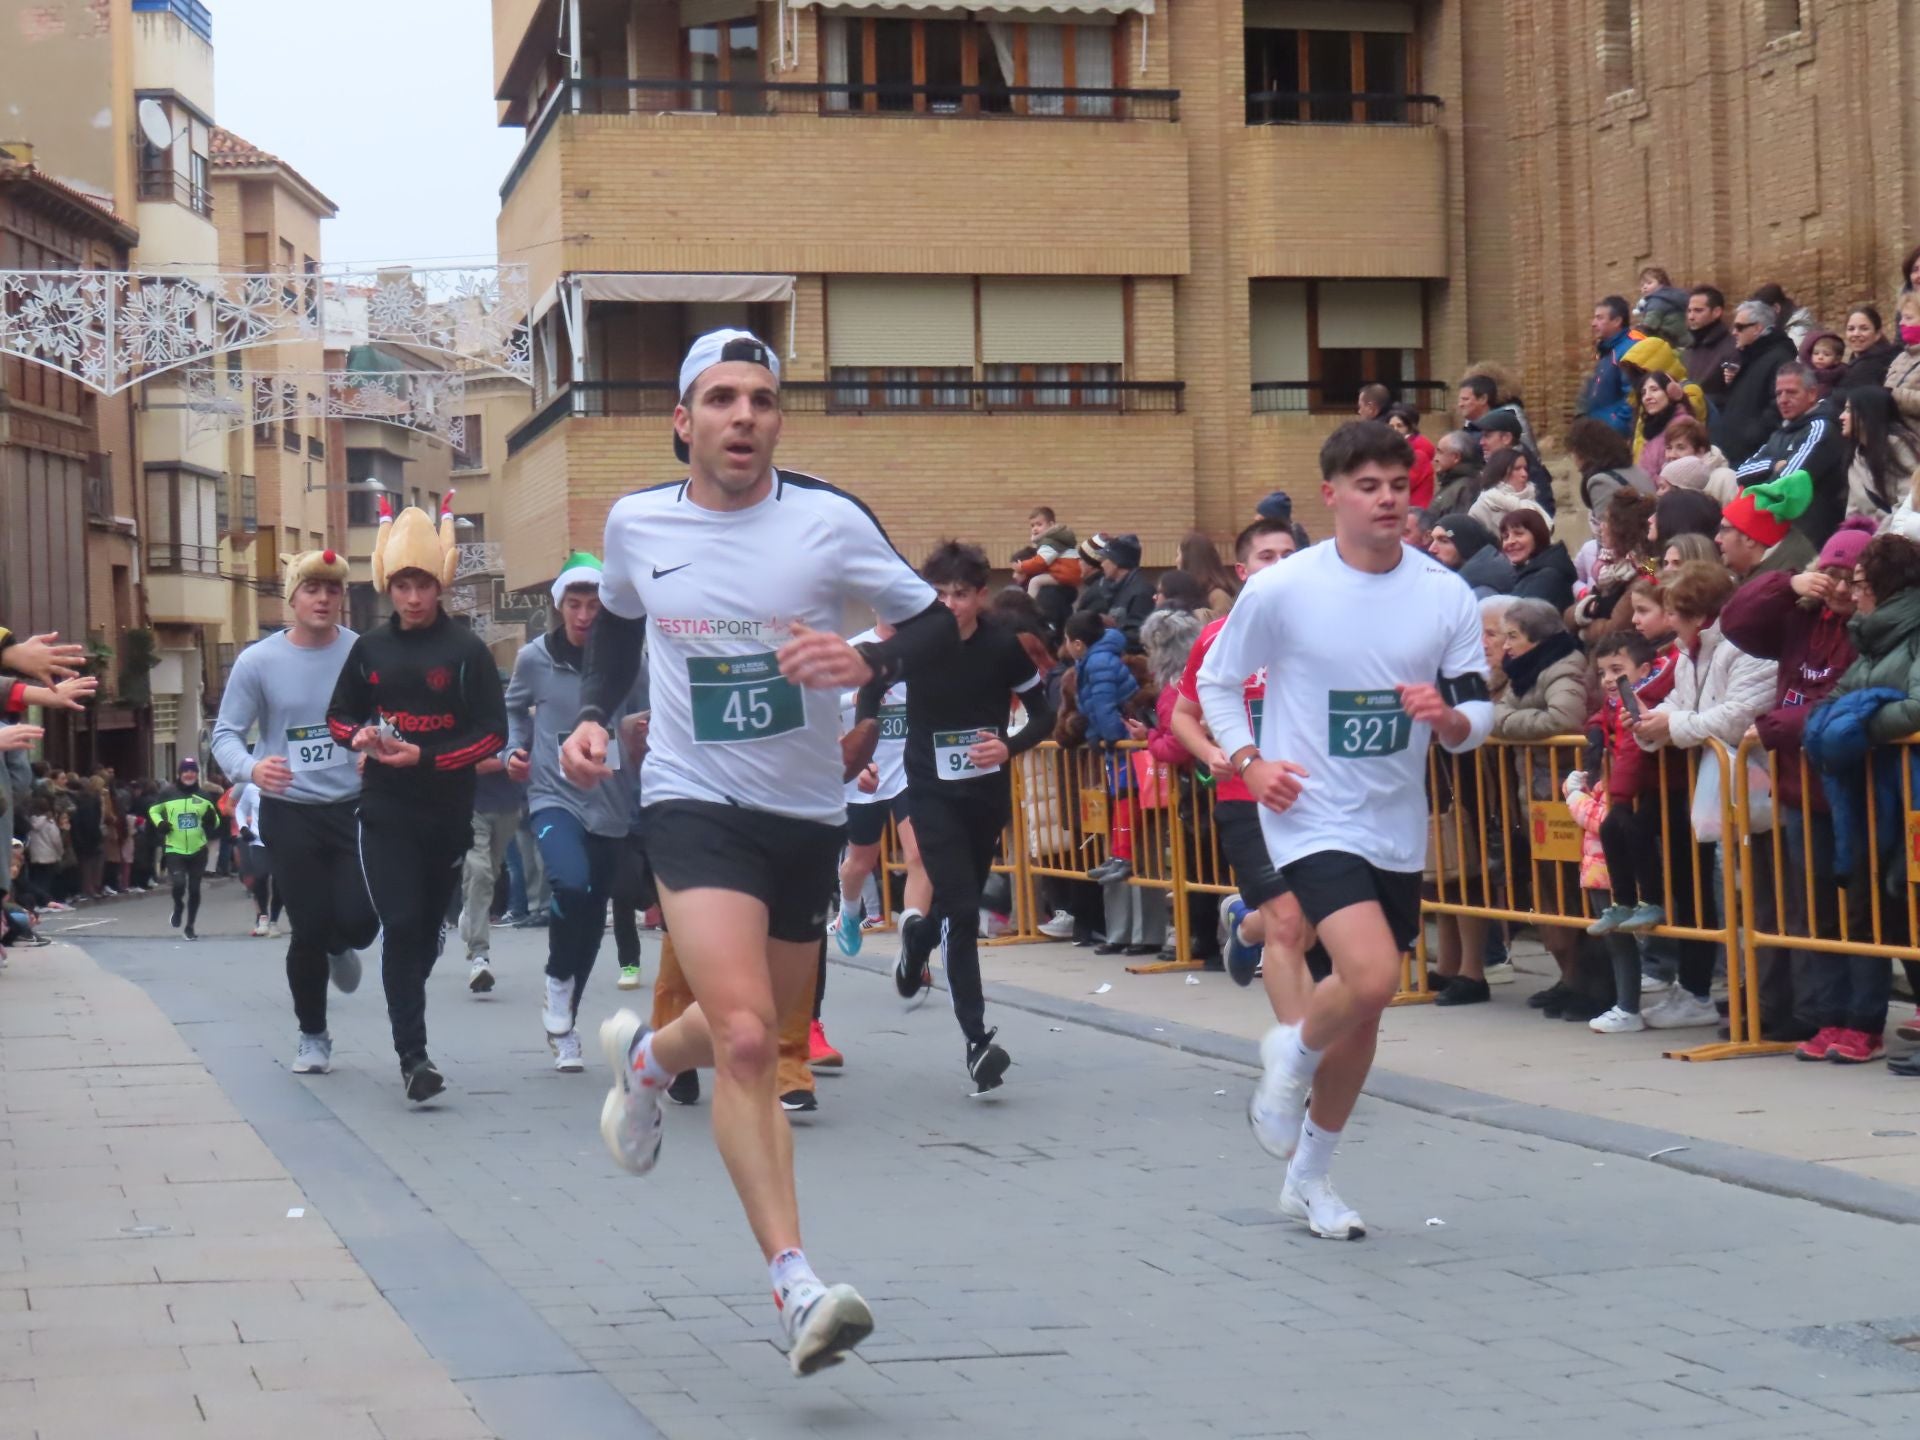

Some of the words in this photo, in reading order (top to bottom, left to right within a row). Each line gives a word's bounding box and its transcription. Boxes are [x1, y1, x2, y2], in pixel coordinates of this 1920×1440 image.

[722, 687, 773, 732] 45
[397, 711, 455, 732] Tezos
[1343, 716, 1398, 752] 321
[300, 743, 334, 763] 927
[949, 752, 976, 771] 92
